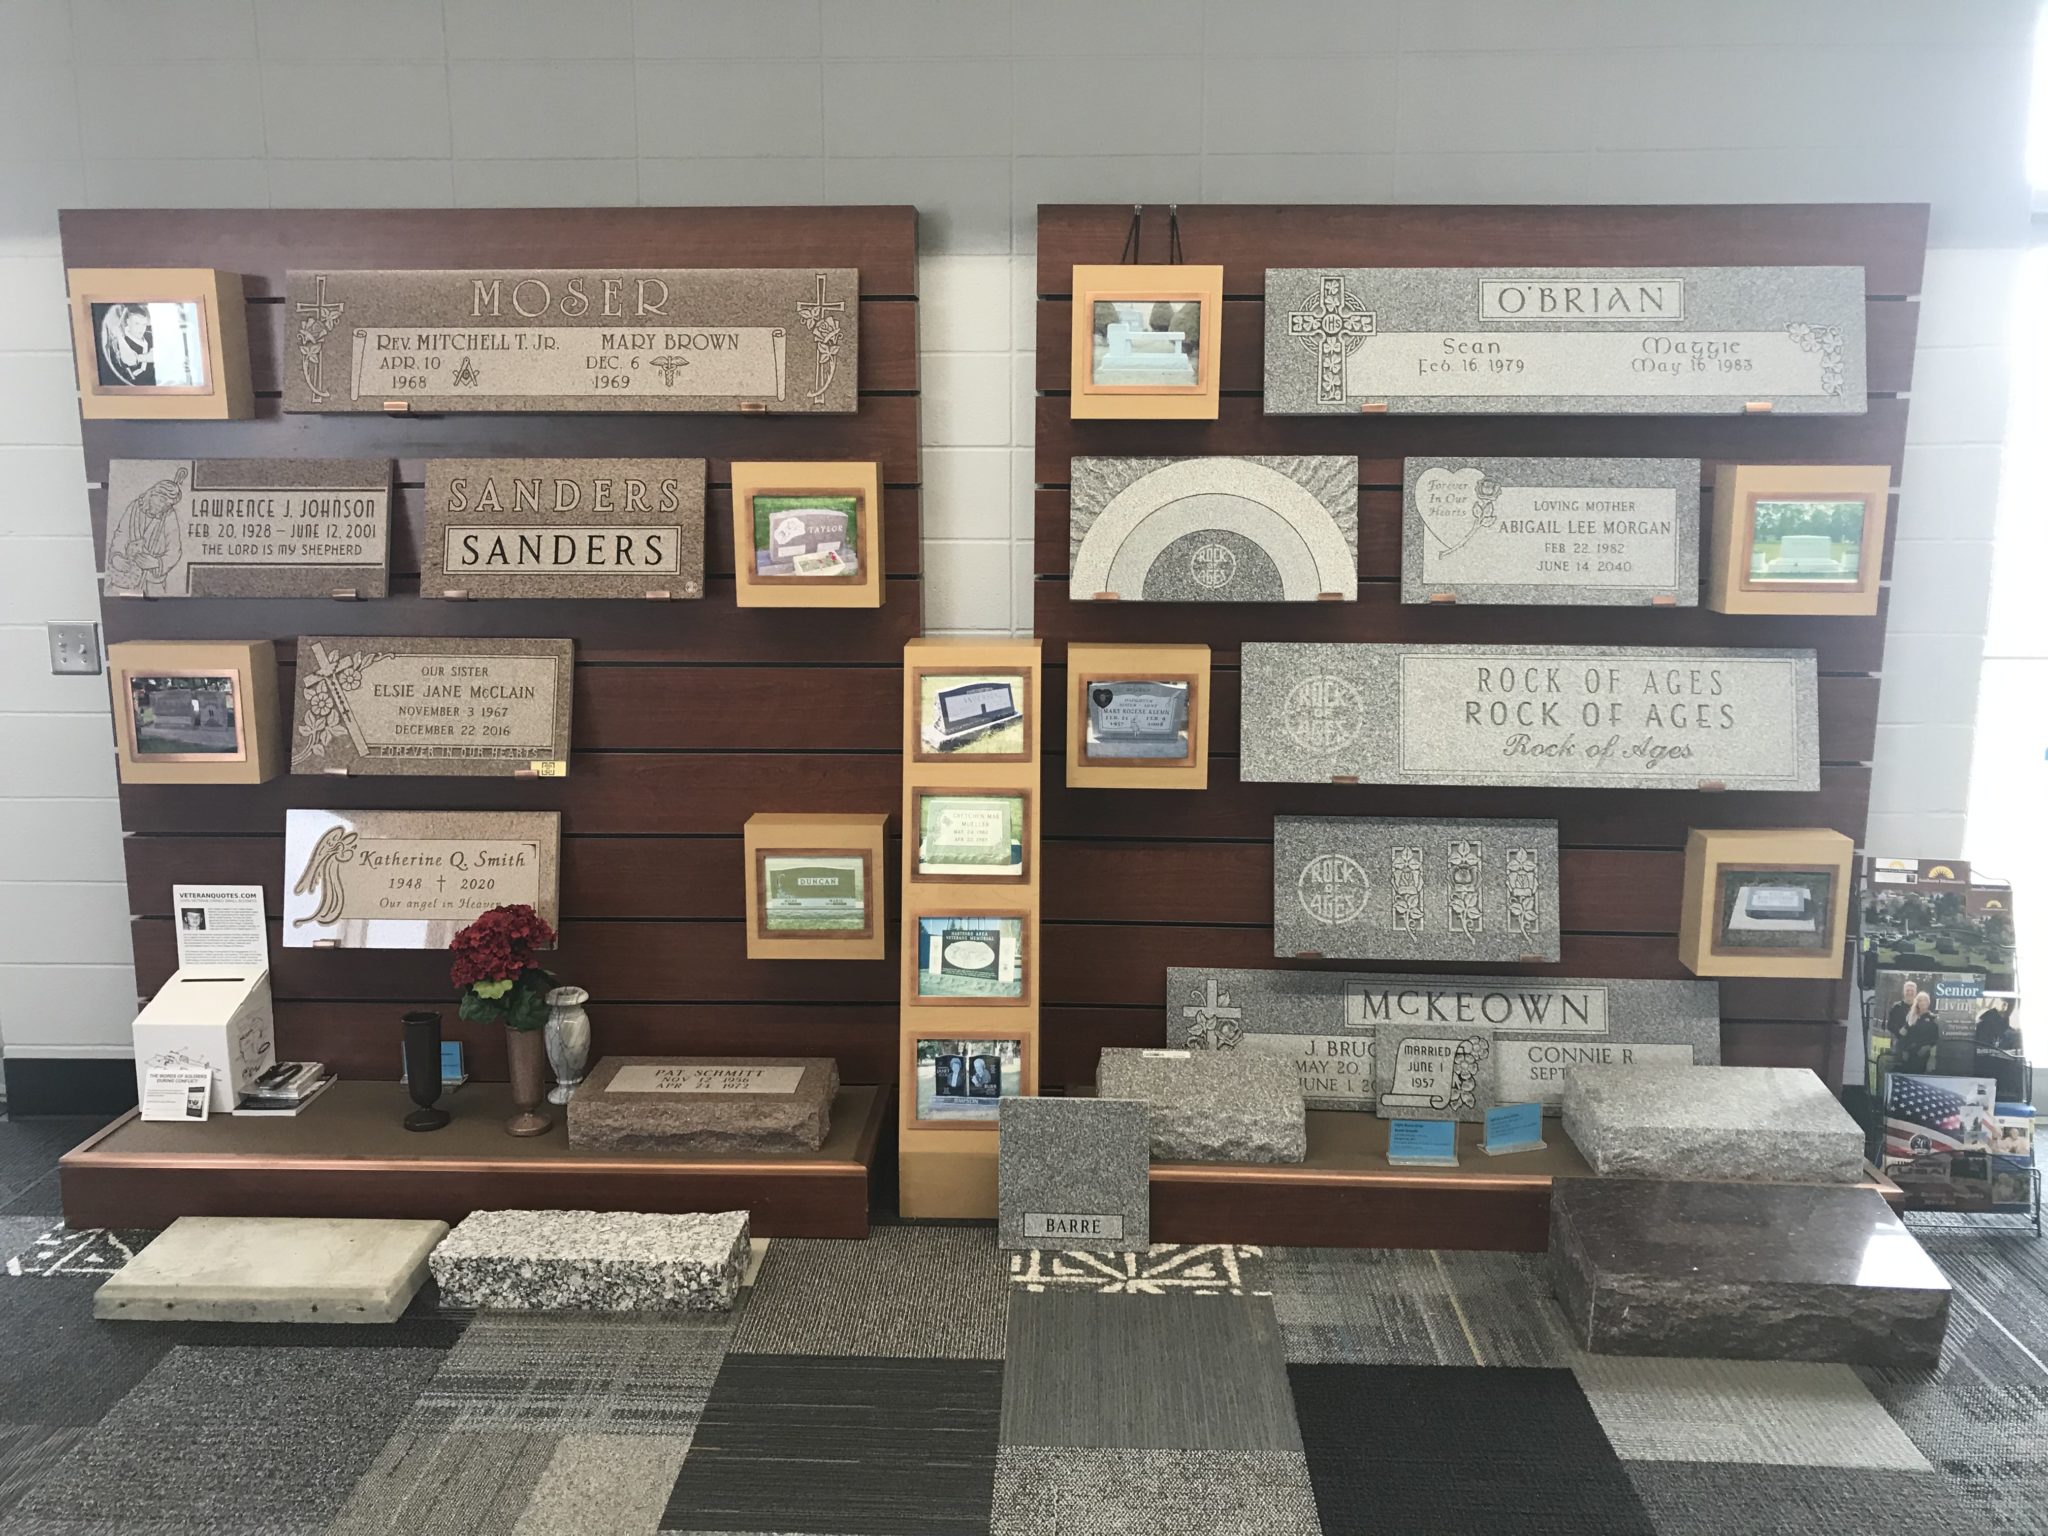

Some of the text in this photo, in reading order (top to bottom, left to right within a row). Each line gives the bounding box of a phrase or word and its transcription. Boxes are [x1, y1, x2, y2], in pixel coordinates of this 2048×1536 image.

[469, 276, 669, 318] MOSER
[1498, 285, 1664, 313] O'BRIAN
[417, 334, 510, 351] MITCHELL
[514, 334, 528, 351] T.
[601, 334, 739, 350] MARY BROWN
[1442, 337, 1501, 355] Sean
[1642, 336, 1741, 360] Maggie
[379, 356, 441, 370] APR. 10
[586, 356, 640, 370] DEC. 6
[1489, 359, 1525, 373] 1979
[1631, 358, 1682, 376] May
[1717, 359, 1753, 373] 1983
[392, 375, 427, 389] 1968
[593, 375, 630, 389] 1969
[1427, 479, 1469, 492] Forever
[448, 477, 679, 513] SANDERS
[1428, 493, 1467, 503] In Our
[191, 499, 375, 518] LAWRENCE J. JOHNSON
[1427, 506, 1467, 517] Hearts
[1533, 501, 1636, 512] LOVING MOTHER
[188, 523, 210, 538] FEB
[242, 523, 272, 538] 1928
[290, 523, 320, 538] JUNE
[345, 523, 376, 538] 2001
[808, 525, 843, 535] TAYLOR
[1499, 520, 1672, 535] ABIGAIL LEE MORGAN
[202, 544, 223, 556] THE
[228, 544, 258, 556] LORD
[262, 544, 273, 556] IS
[301, 544, 362, 556] SHEPHERD
[461, 534, 663, 566] SANDERS
[1197, 548, 1228, 562] ROCK
[1544, 543, 1566, 553] FEB
[1597, 543, 1625, 553] 1982
[1536, 561, 1570, 572] JUNE
[1597, 561, 1632, 572] 2040
[1198, 569, 1226, 584] AGES
[421, 666, 489, 677] OUR SISTER
[1477, 667, 1723, 696] ROCK OF AGES
[373, 683, 535, 699] ELSIE JANE McCLAIN
[398, 706, 509, 718] NOVEMBER 3 1967
[1465, 701, 1735, 729] ROCK OF AGES
[395, 724, 510, 736] DECEMBER 22 2016
[380, 746, 538, 759] FOREVER IN OUR HEARTS
[1503, 733, 1695, 769] Rock of Ages
[358, 850, 526, 871] Katherine Q. Smith
[1311, 859, 1355, 883] ROCK
[388, 877, 496, 890] 1948 2020
[799, 878, 837, 886] DUNCAN
[379, 896, 502, 912] Our angel in Heaven
[1310, 894, 1355, 919] AGES
[1936, 982, 1979, 997] Senior
[1304, 1040, 1318, 1057] J.
[1404, 1044, 1451, 1057] MARRIED
[1528, 1046, 1638, 1065] CONNIE R.
[655, 1069, 765, 1077] PAT SCHMITT
[1295, 1060, 1329, 1074] MAY
[1407, 1061, 1444, 1073] JUNE 1
[1410, 1077, 1435, 1088] 1957
[1046, 1218, 1102, 1234] BARRE
